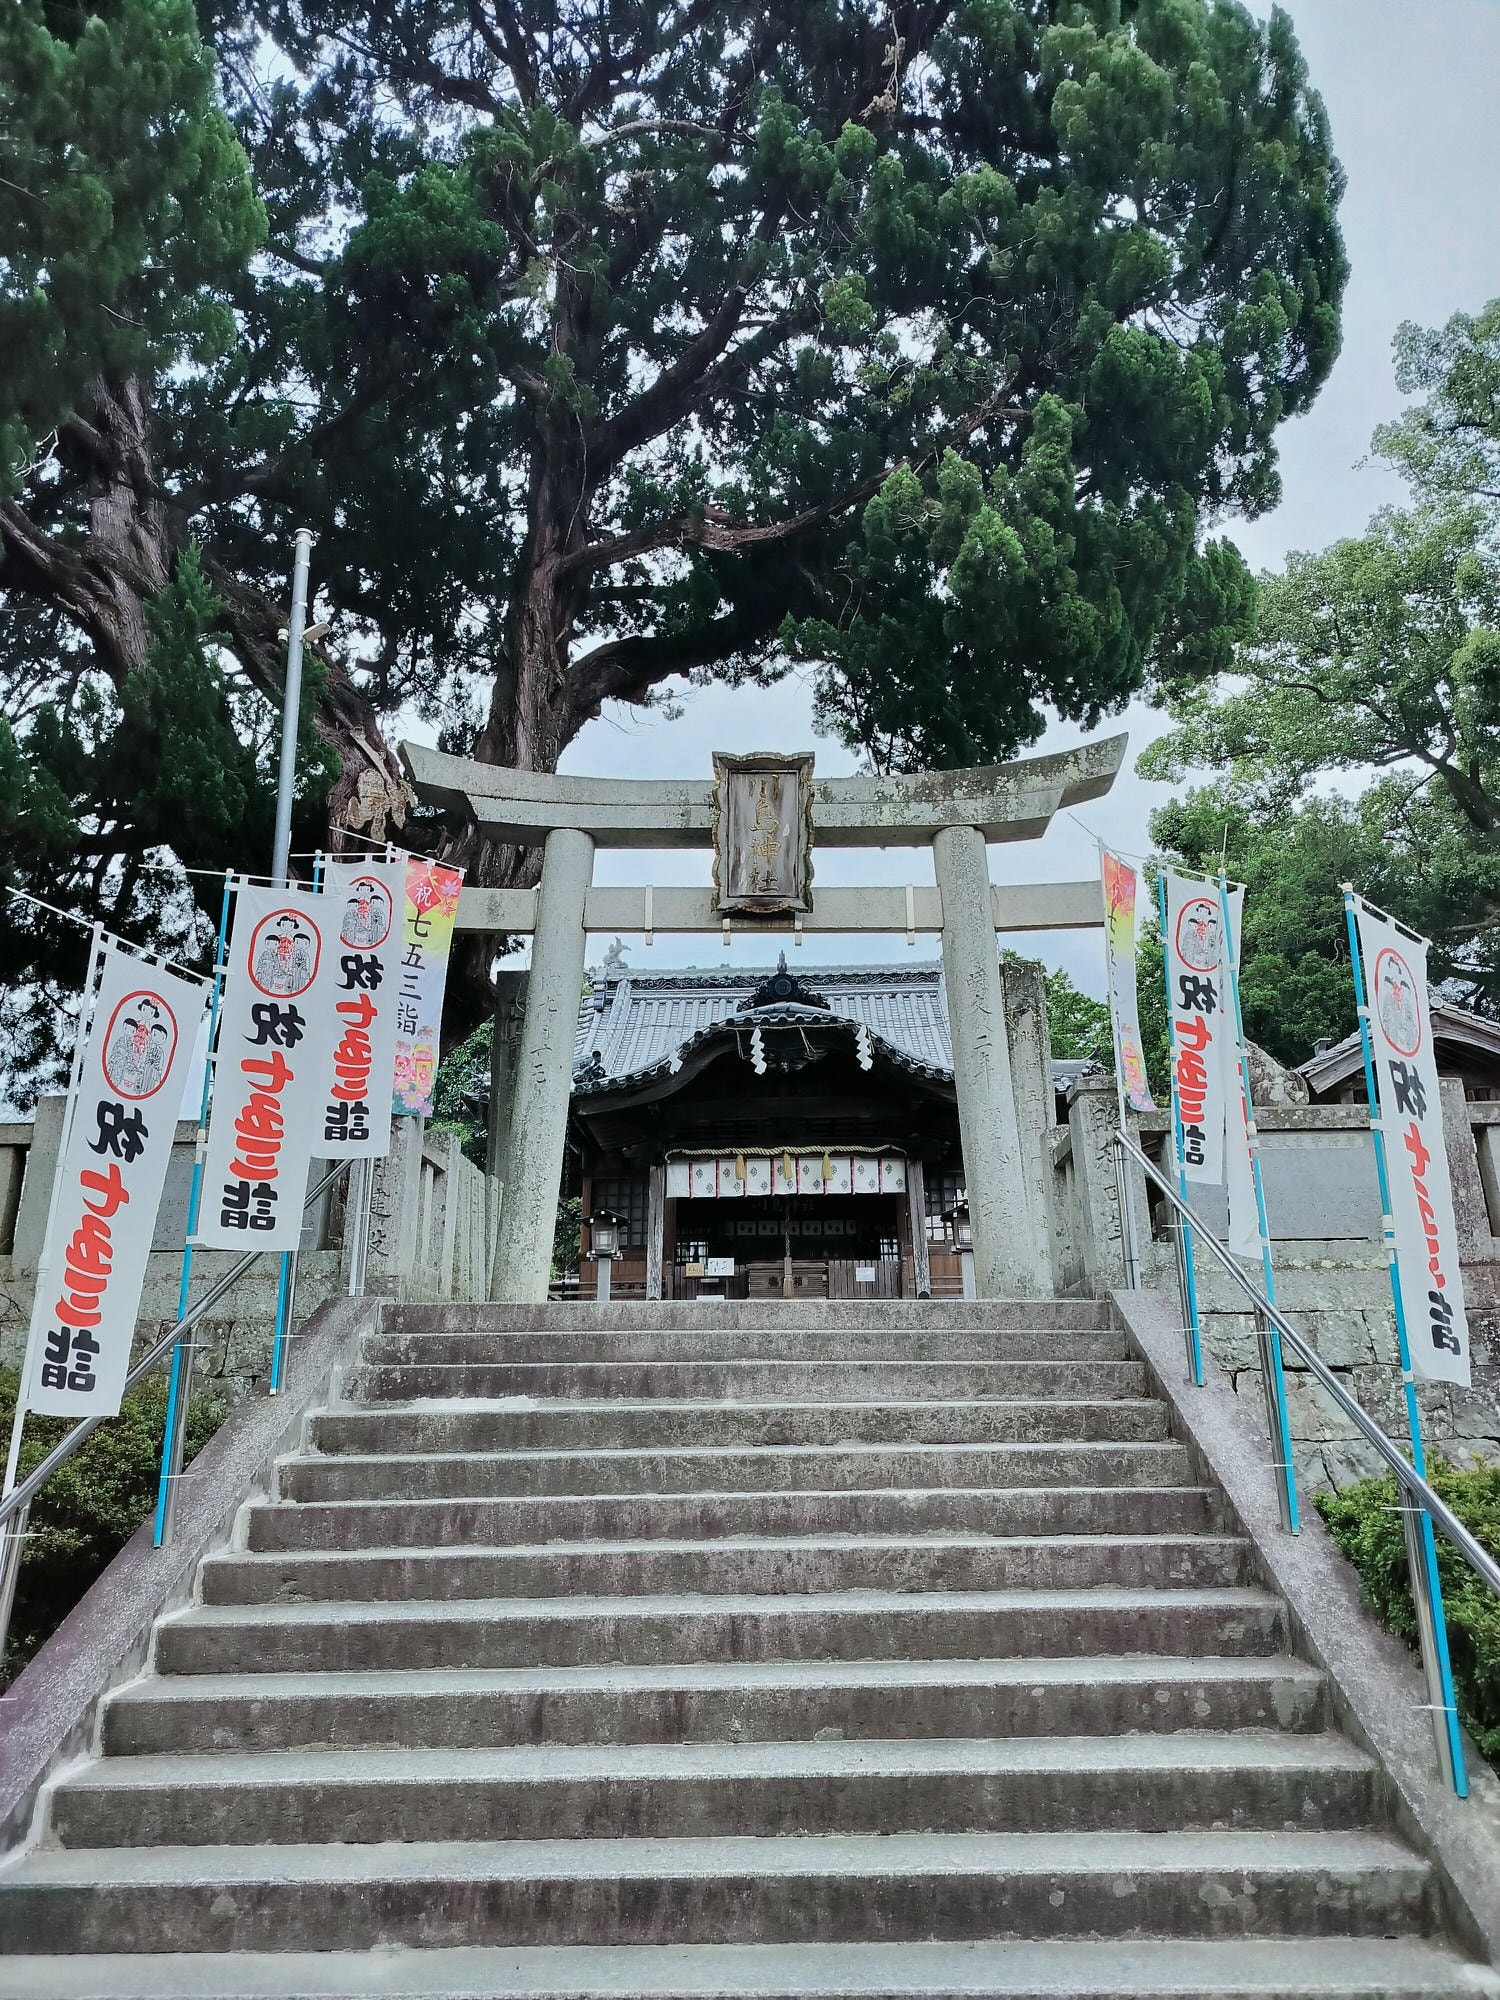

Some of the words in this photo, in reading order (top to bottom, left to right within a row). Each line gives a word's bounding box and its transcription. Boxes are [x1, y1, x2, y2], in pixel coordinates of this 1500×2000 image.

[413, 882, 434, 907] 祝
[396, 908, 433, 1037] 七五三詣
